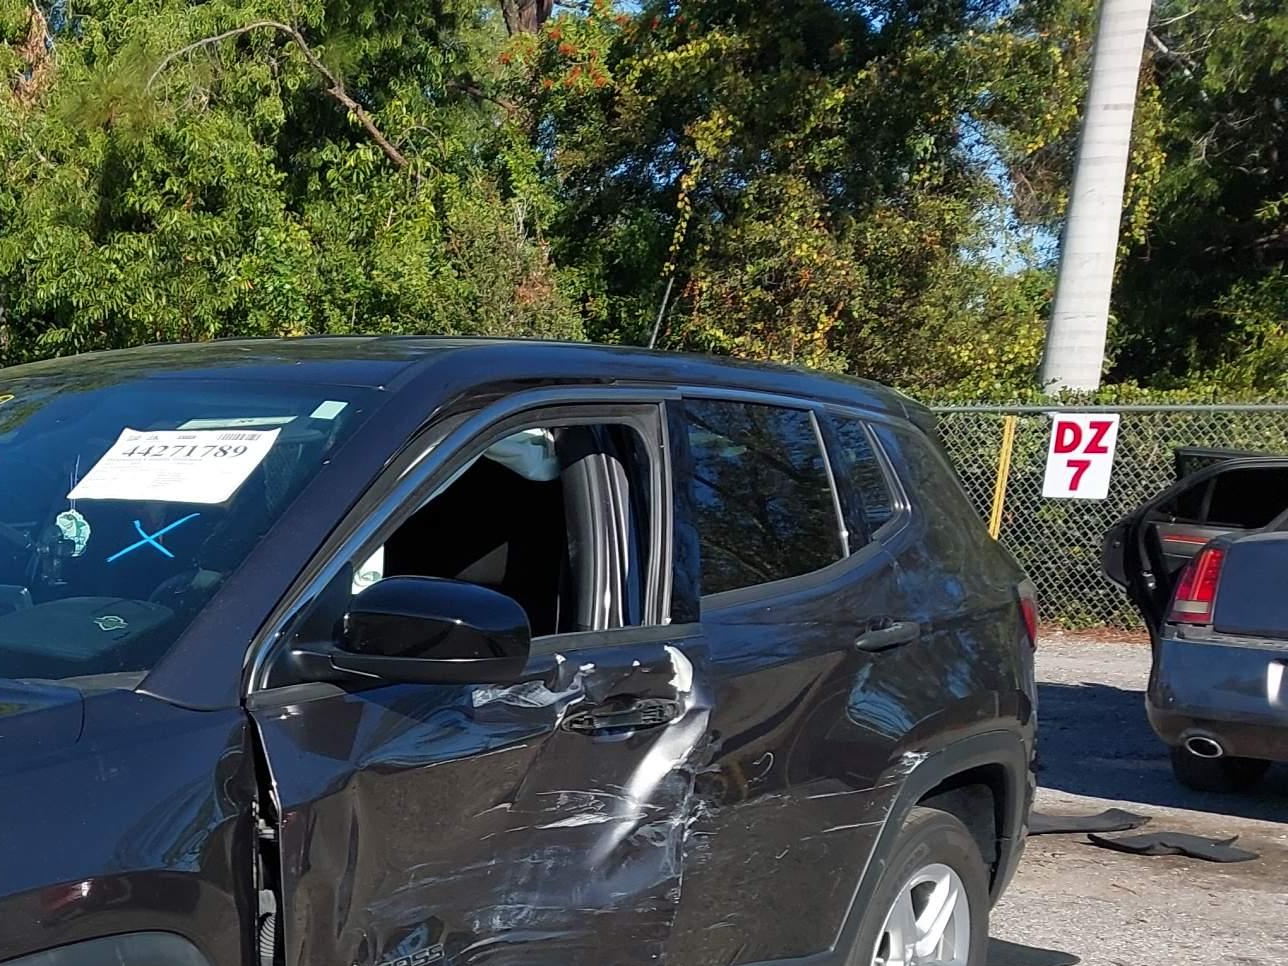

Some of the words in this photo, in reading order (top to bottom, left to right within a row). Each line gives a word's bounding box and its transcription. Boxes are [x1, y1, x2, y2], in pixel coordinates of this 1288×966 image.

[122, 445, 248, 458] 44271789
[1053, 421, 1113, 455] DZ
[1067, 459, 1092, 492] 7
